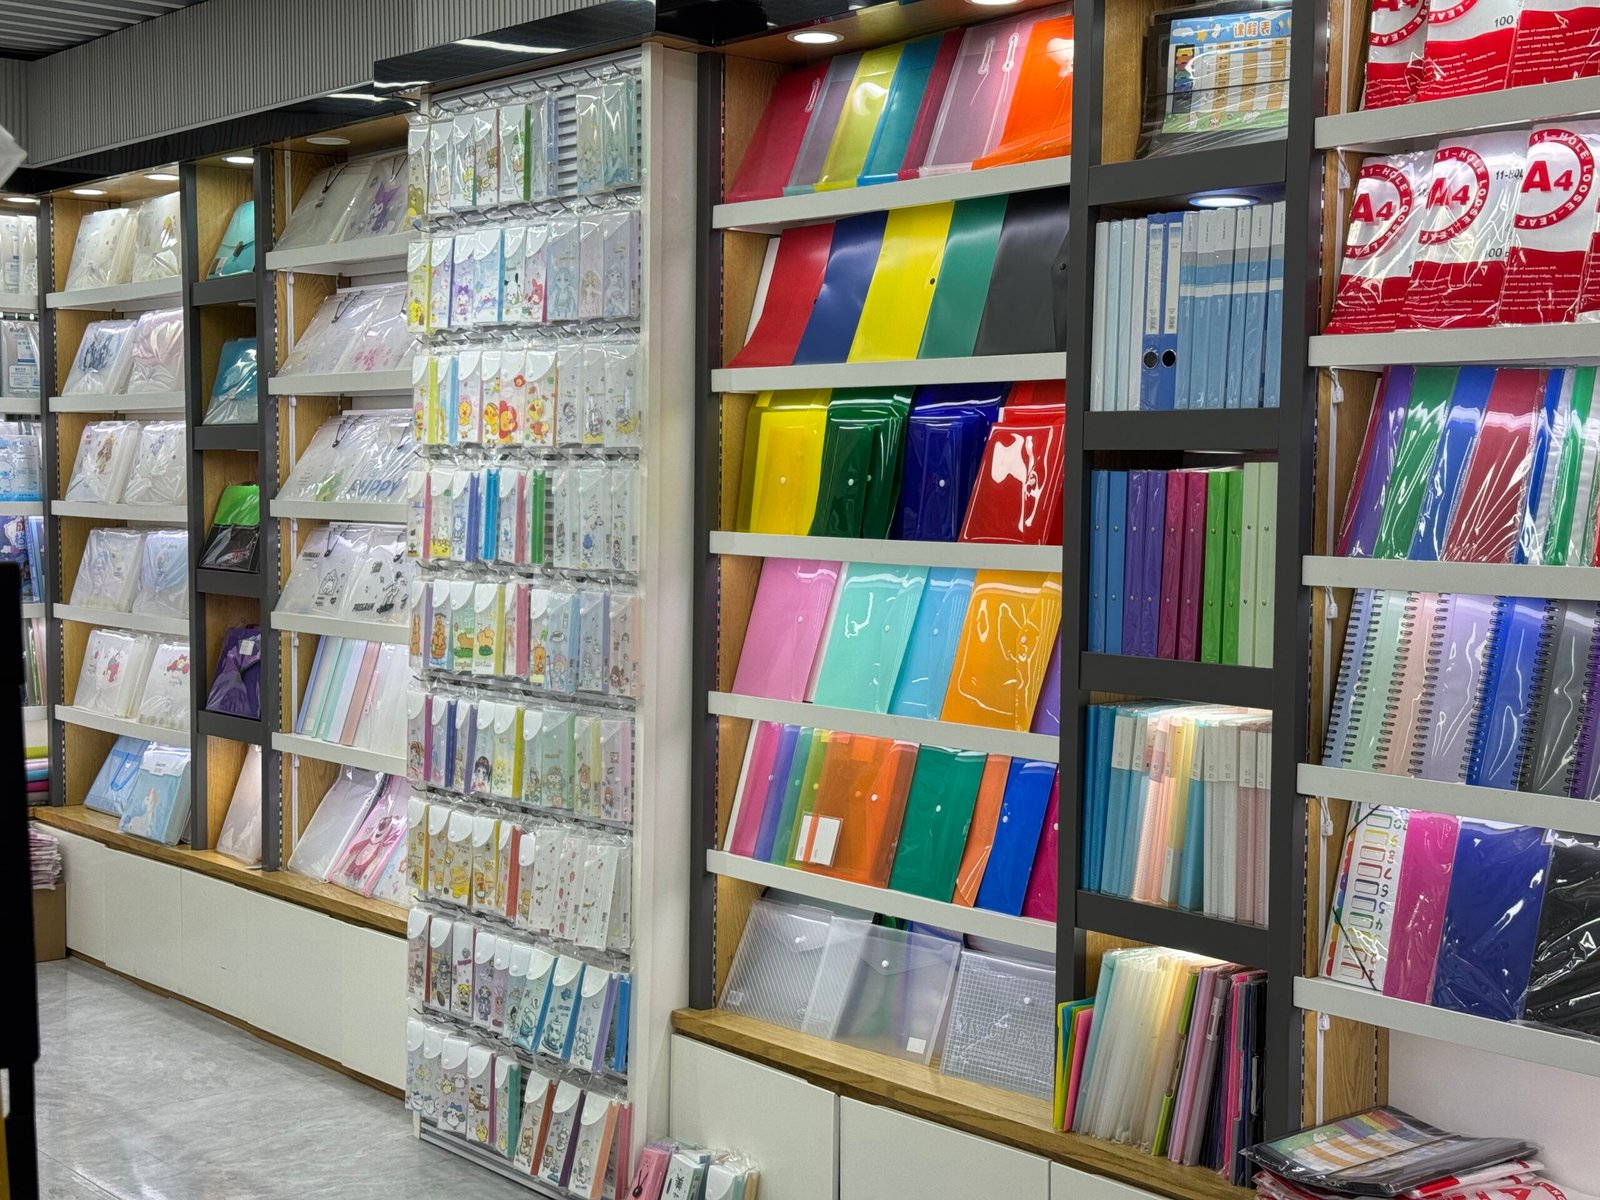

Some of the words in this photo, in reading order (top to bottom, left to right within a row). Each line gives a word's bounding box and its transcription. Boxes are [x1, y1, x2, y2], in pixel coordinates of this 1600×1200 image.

[1494, 15, 1514, 28] 100
[1534, 132, 1589, 160] 11-HOLE
[1436, 150, 1485, 175] 11-HOLE
[1495, 168, 1524, 180] 11-HOL
[1360, 167, 1409, 191] 11-HOLE
[1520, 160, 1573, 193] A4
[1425, 177, 1470, 210] A4
[1519, 164, 1592, 227] LOOSE-LEAF
[1349, 193, 1393, 223] A4
[1387, 850, 1396, 864] 8
[1384, 868, 1392, 880] 7
[1378, 901, 1386, 914] 5
[1375, 918, 1383, 930] 4
